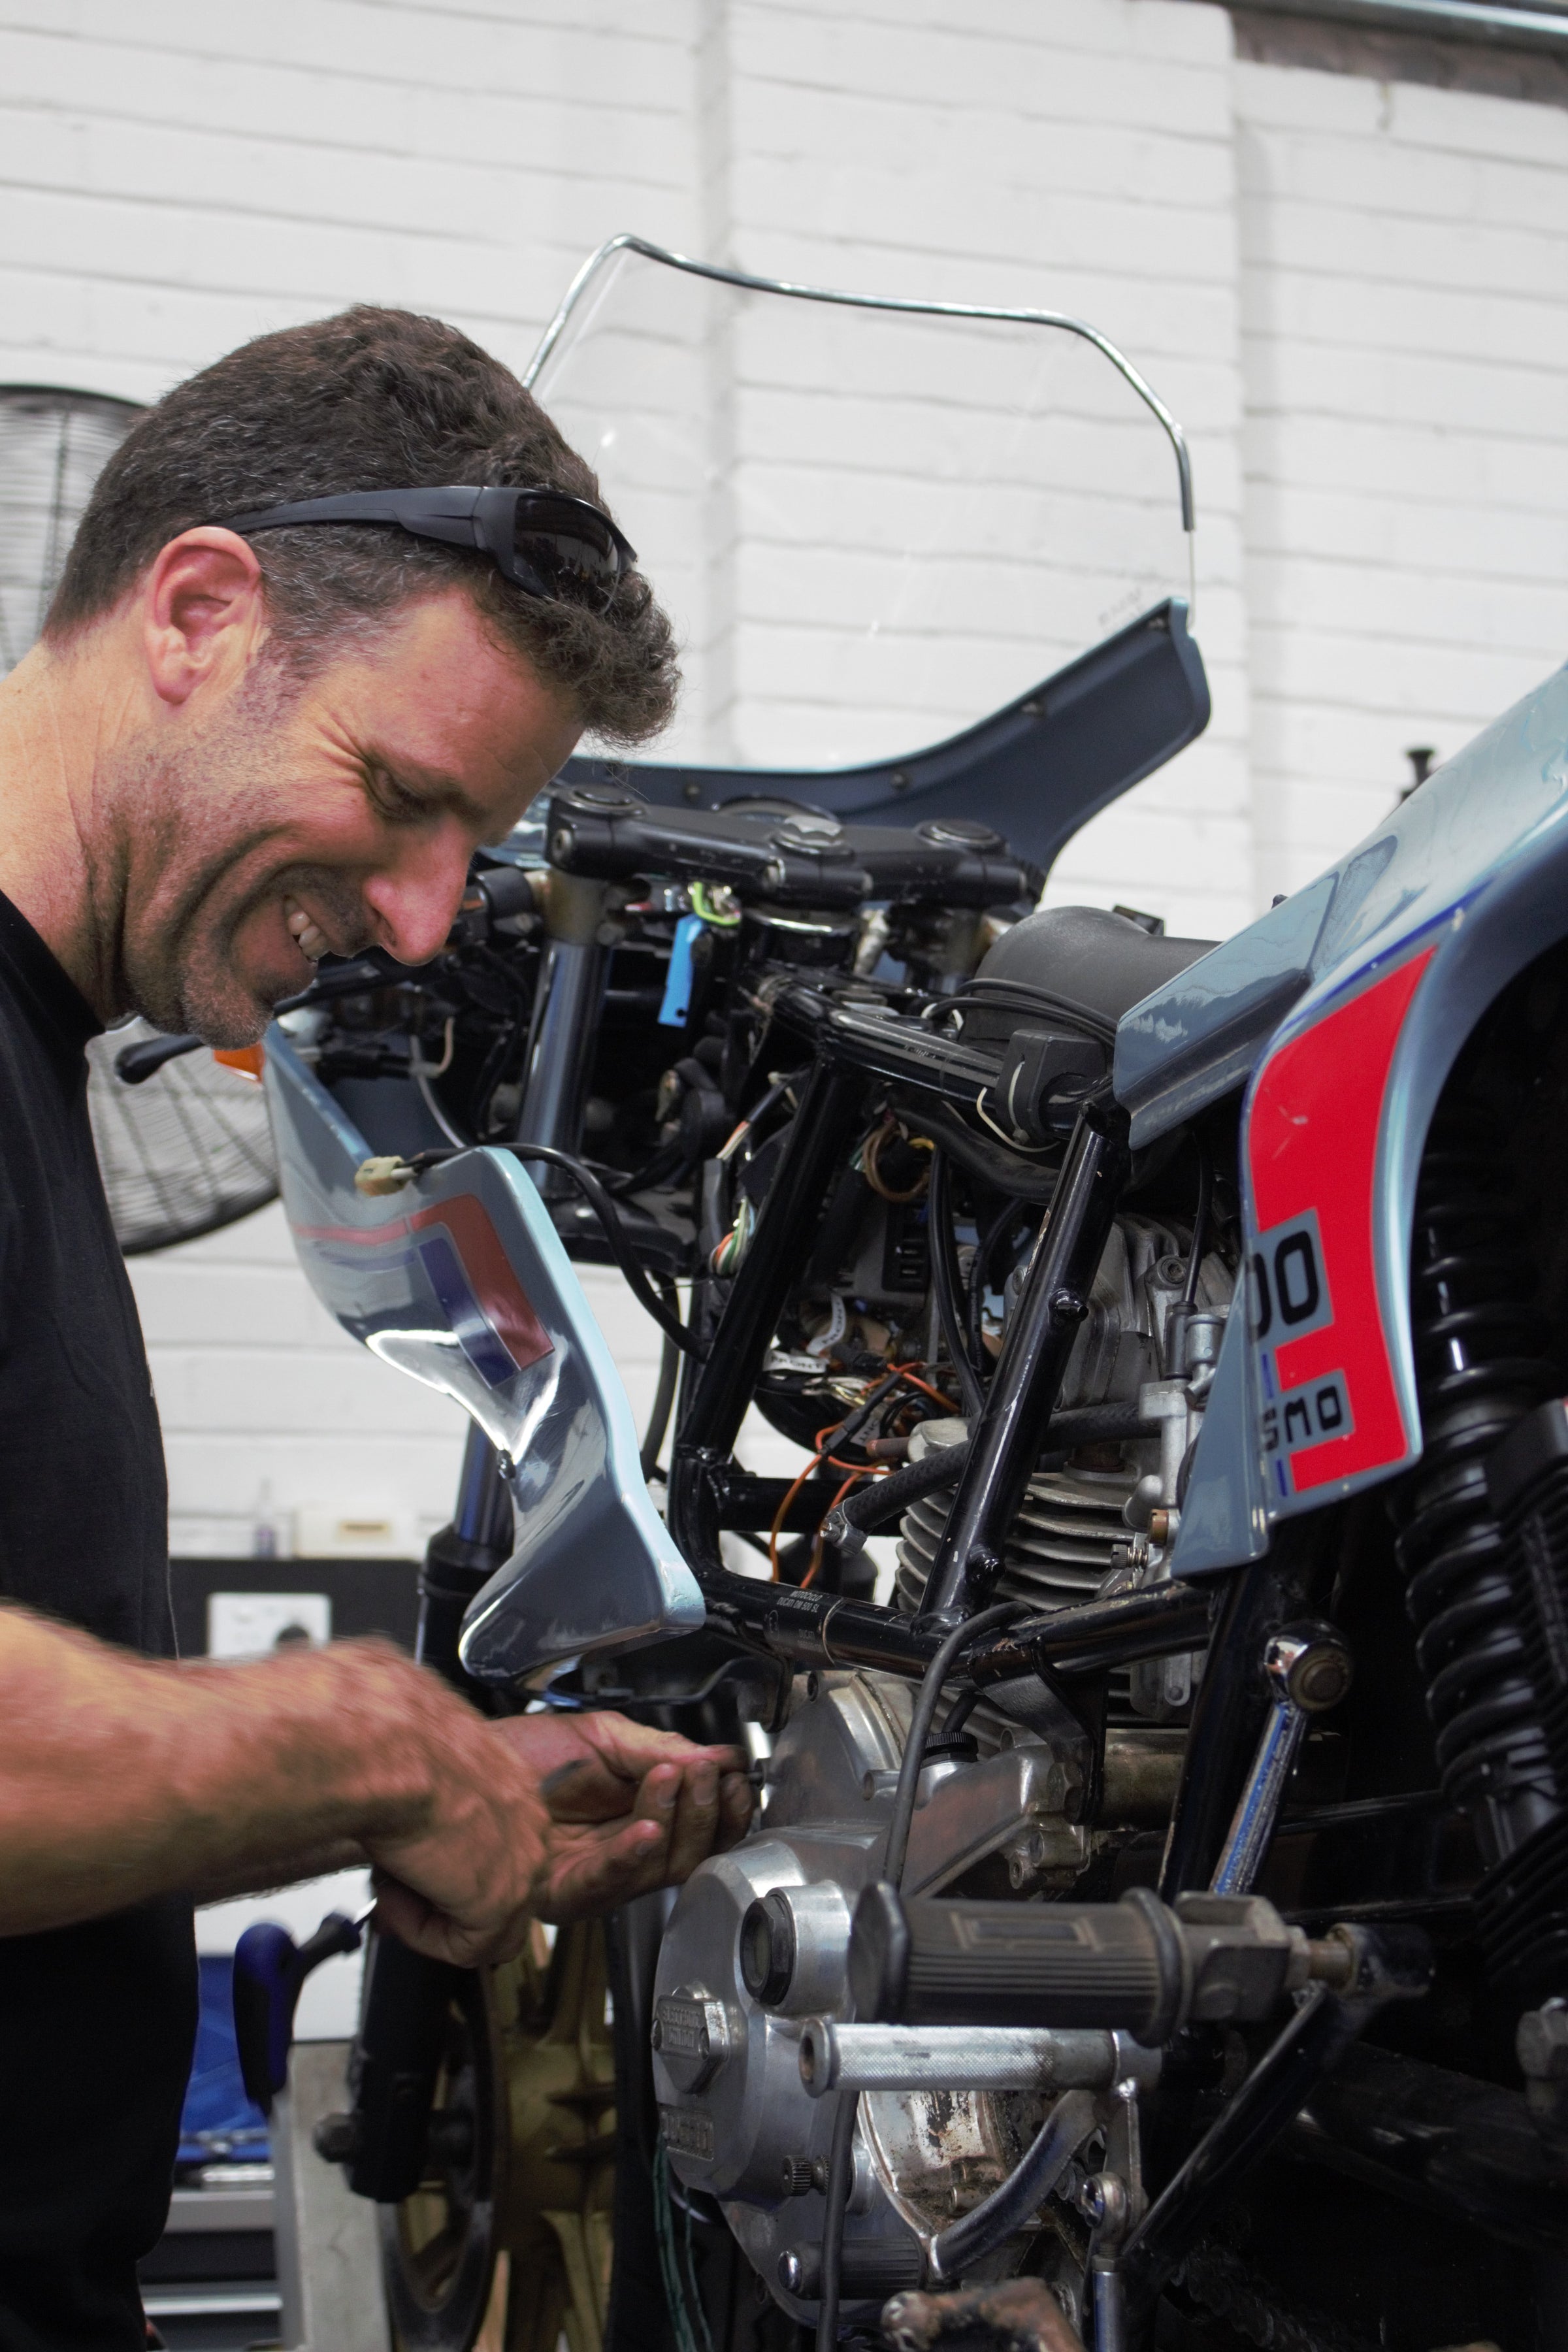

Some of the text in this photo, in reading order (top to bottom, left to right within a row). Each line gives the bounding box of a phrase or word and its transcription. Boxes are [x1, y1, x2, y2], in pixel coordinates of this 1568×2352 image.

[789, 1590, 823, 1601] MOTOCICLO
[776, 1597, 795, 1607] DUCATI
[802, 1601, 813, 1611] 500
[811, 1604, 820, 1613] SL
